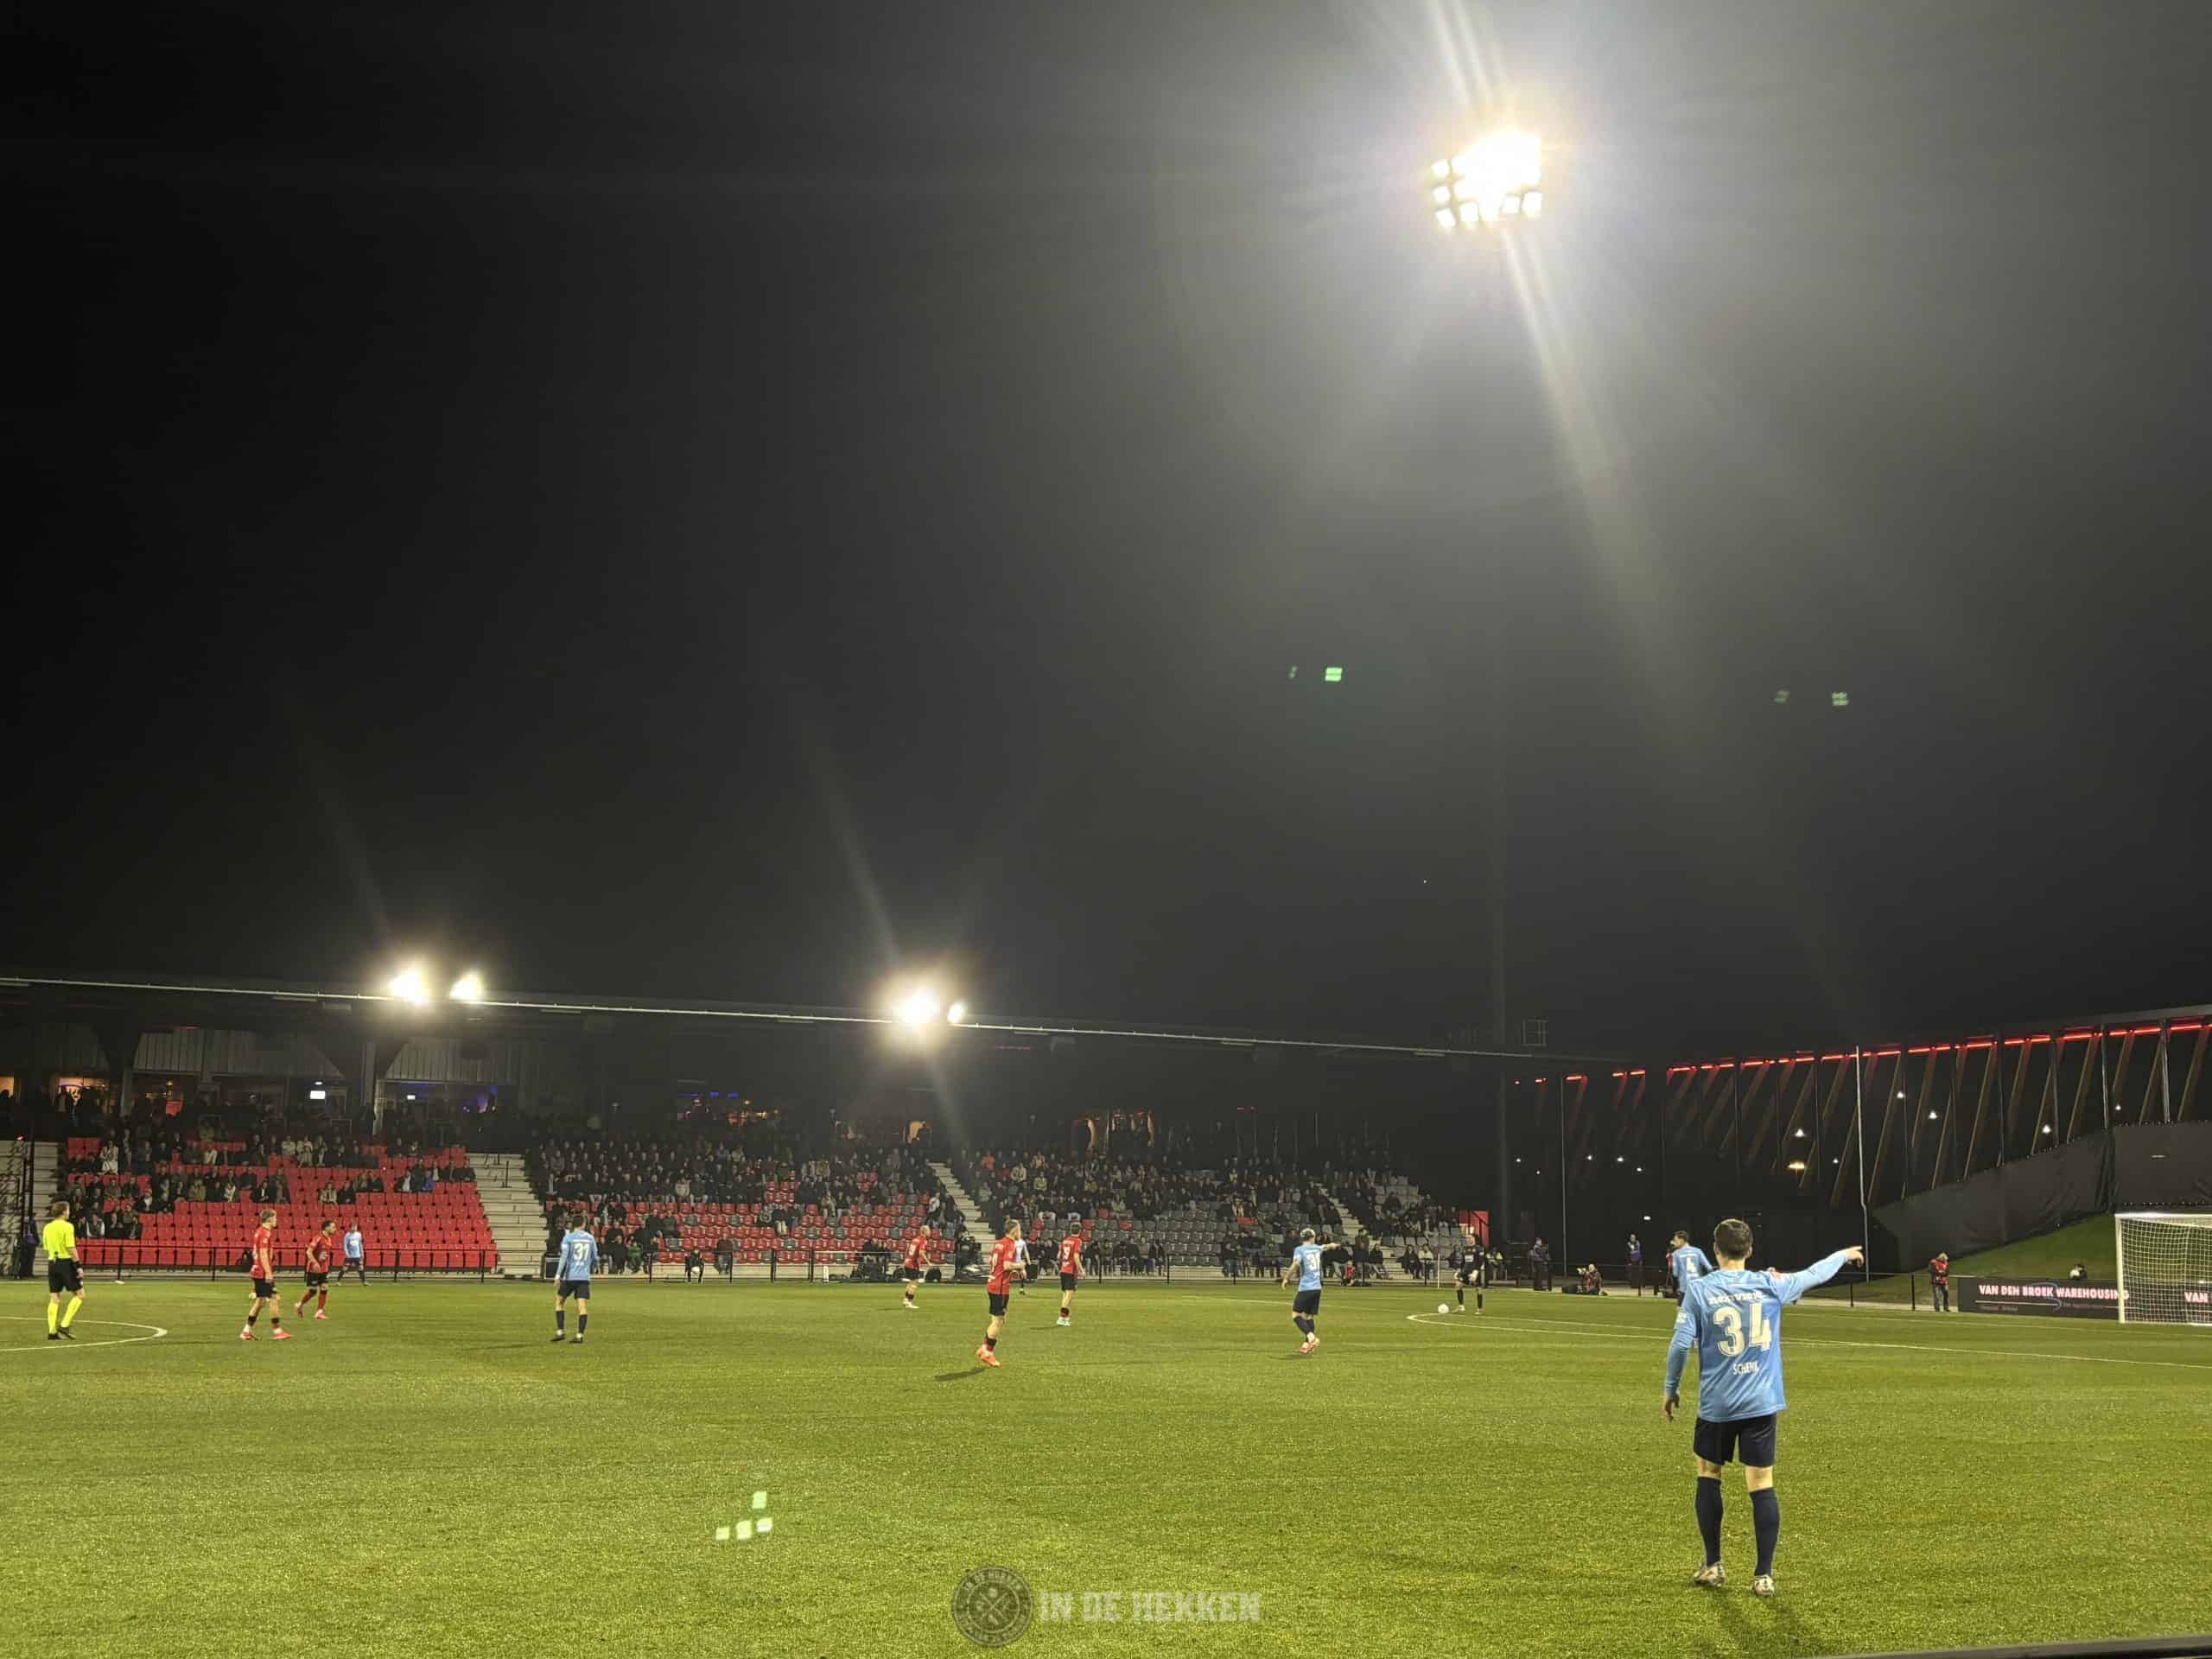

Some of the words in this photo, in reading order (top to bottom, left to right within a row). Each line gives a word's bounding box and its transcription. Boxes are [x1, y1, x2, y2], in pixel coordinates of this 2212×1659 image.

[1979, 1285, 1999, 1295] VAN
[2001, 1285, 2020, 1296] DEN
[2023, 1286, 2054, 1297] BROEK
[2183, 1292, 2209, 1303] VAN
[1713, 1302, 1771, 1357] 34
